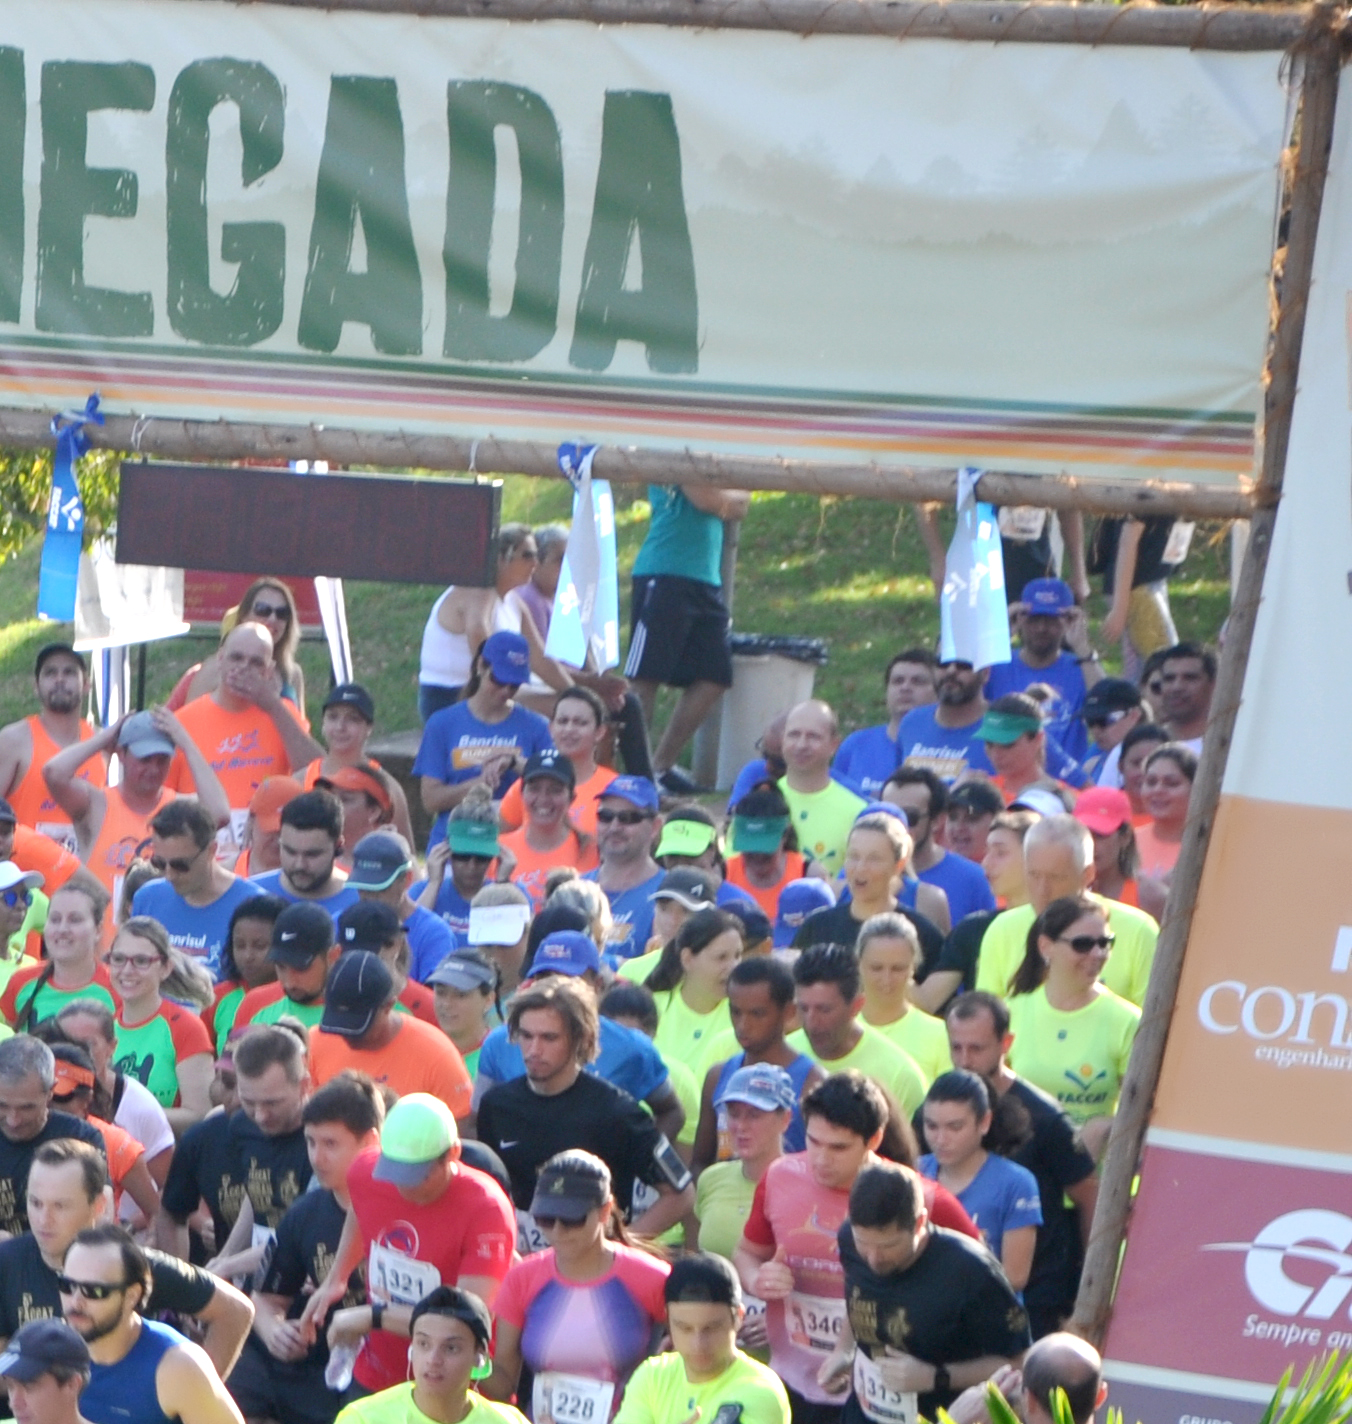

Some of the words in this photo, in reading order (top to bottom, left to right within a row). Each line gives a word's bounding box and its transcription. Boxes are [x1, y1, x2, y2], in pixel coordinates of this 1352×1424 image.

[1198, 979, 1352, 1048] con
[389, 1268, 424, 1291] 321
[1243, 1314, 1321, 1347] Sempre
[556, 1393, 594, 1420] 228
